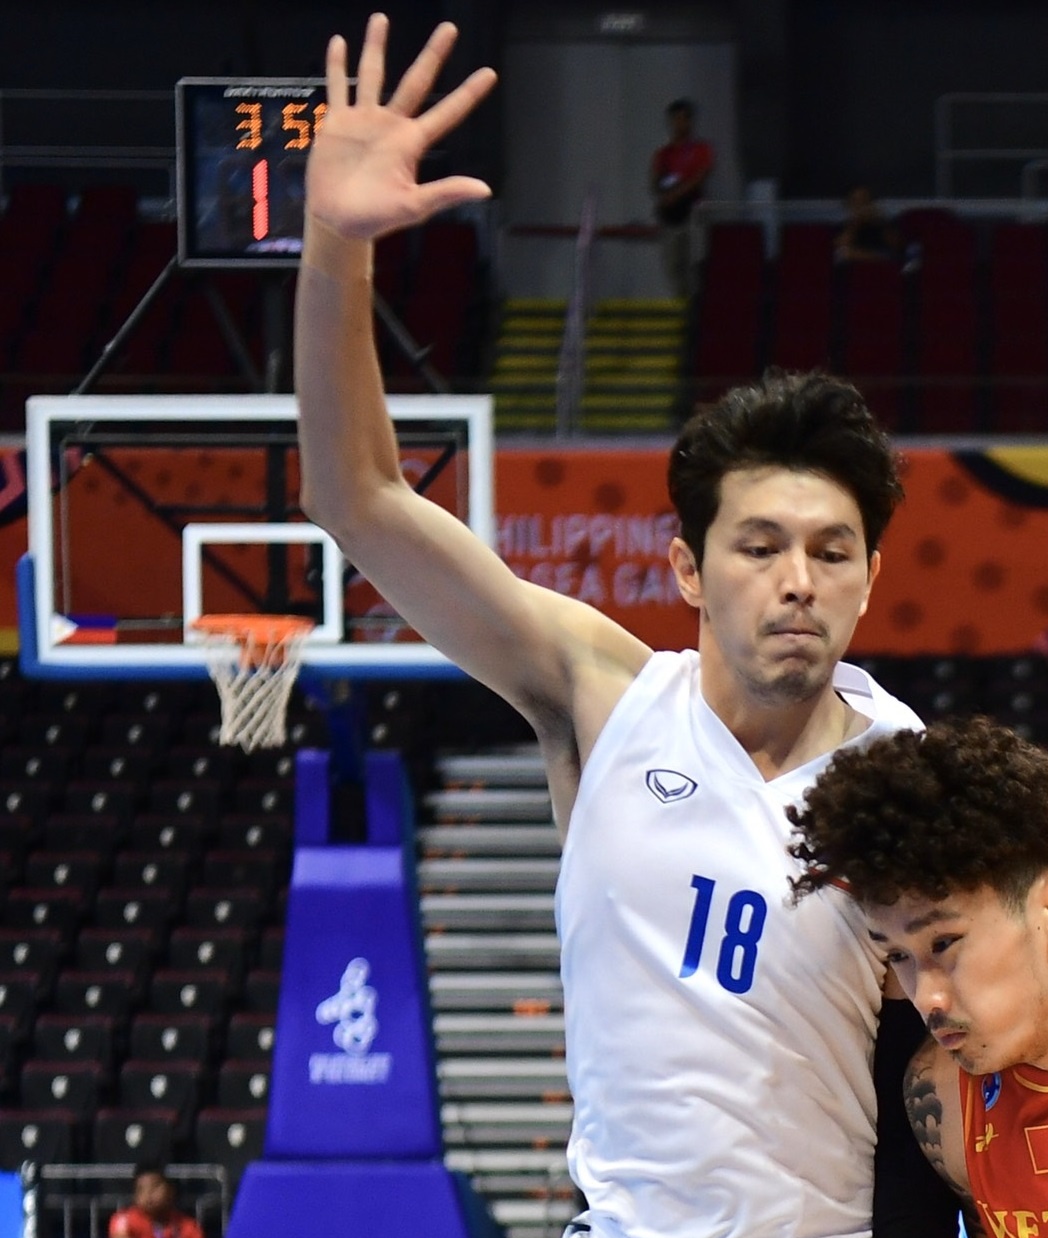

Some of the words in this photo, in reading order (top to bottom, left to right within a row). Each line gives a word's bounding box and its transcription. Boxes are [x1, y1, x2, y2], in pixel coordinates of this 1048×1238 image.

[235, 102, 263, 150] 3
[252, 158, 269, 241] 1
[678, 873, 768, 995] 18
